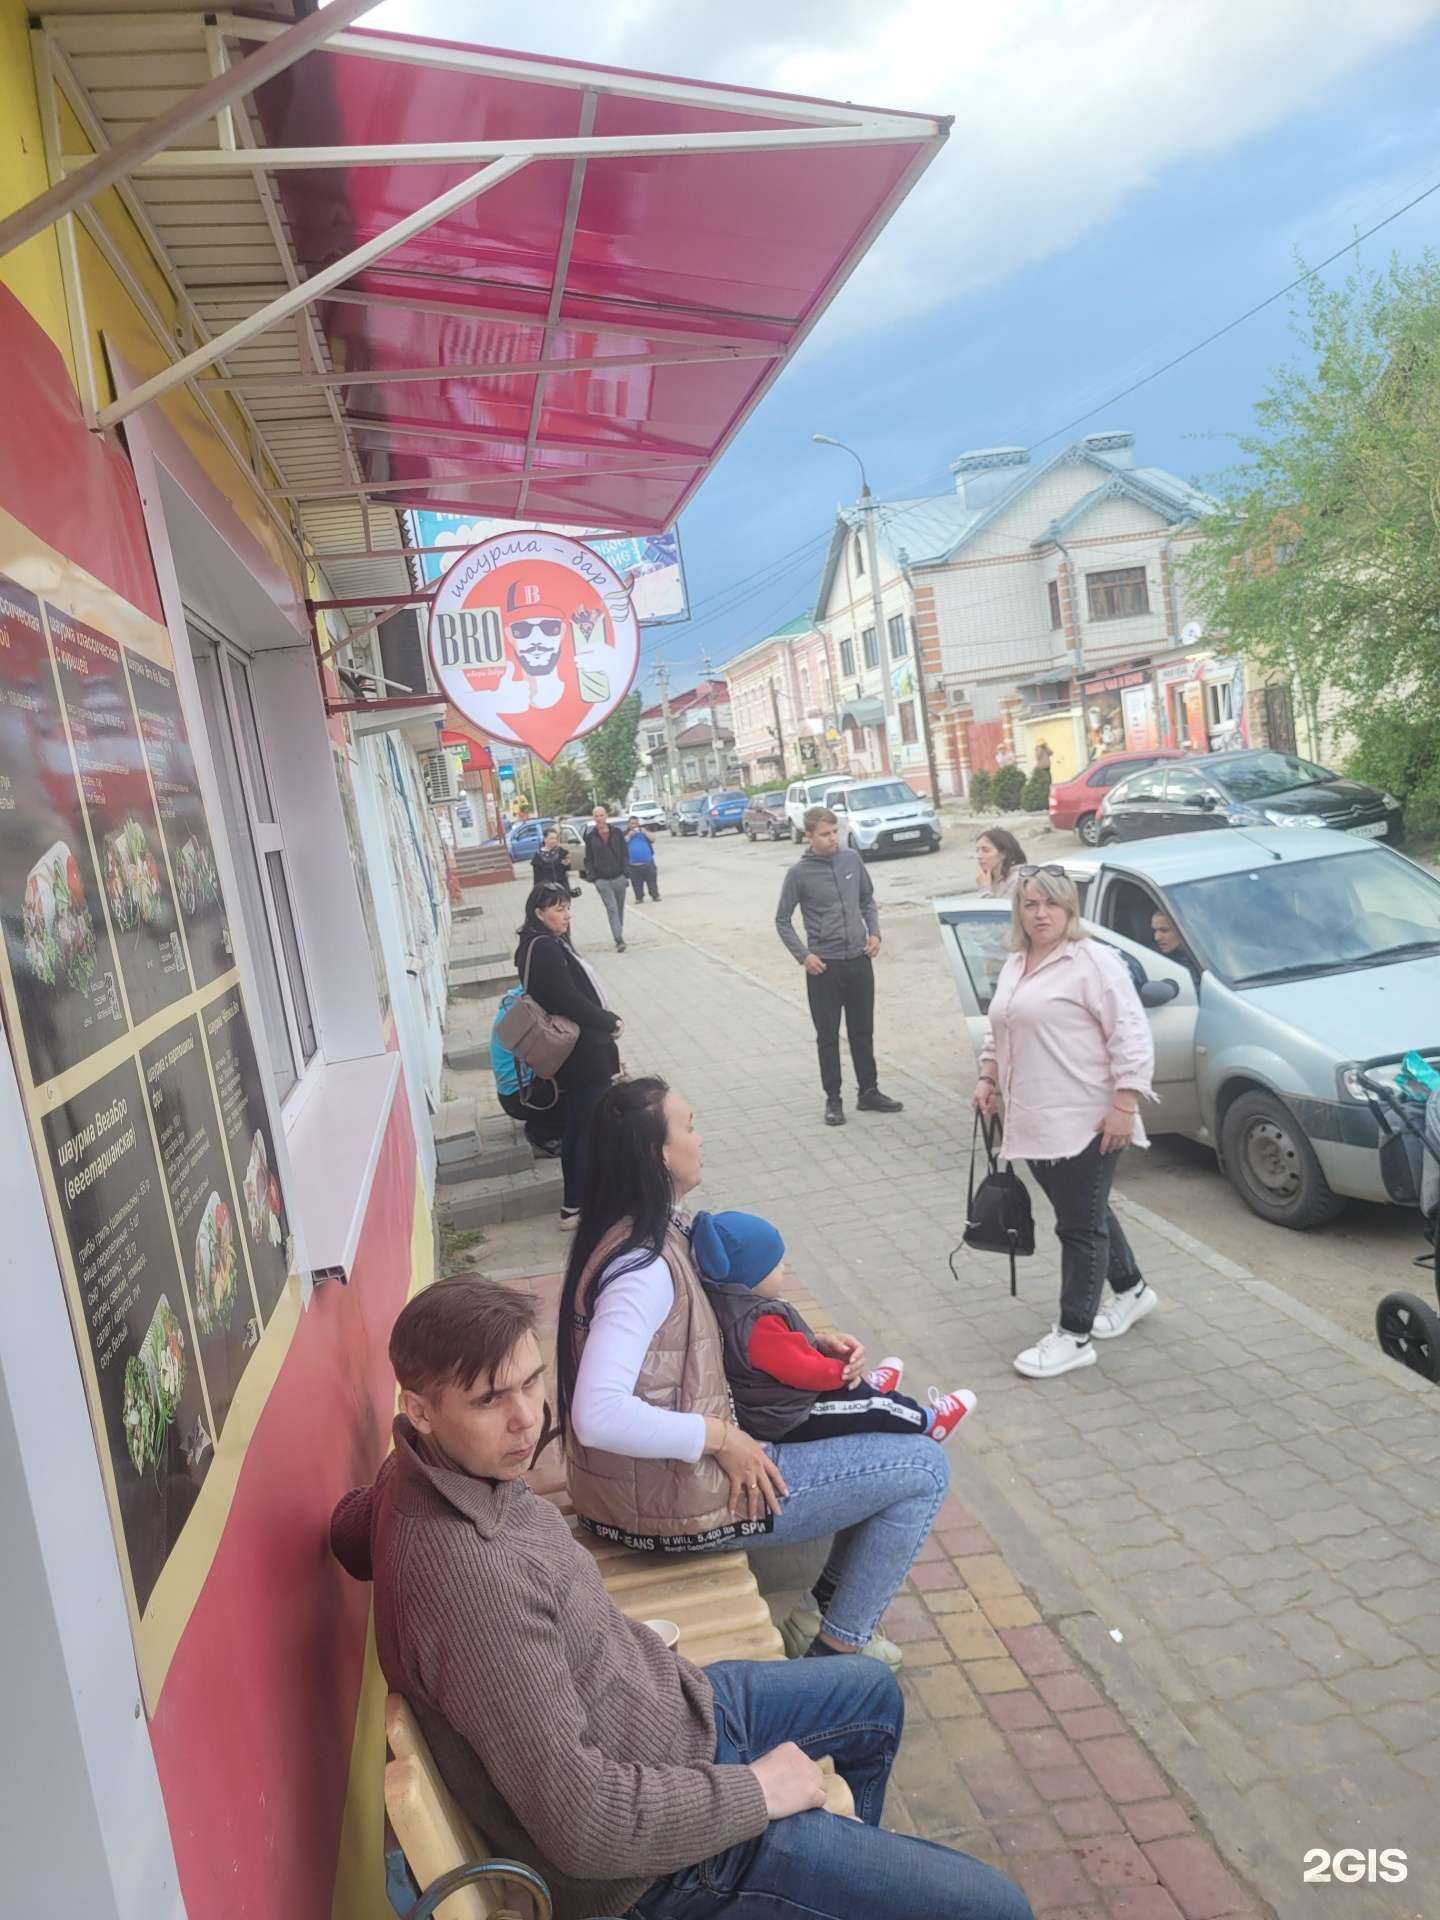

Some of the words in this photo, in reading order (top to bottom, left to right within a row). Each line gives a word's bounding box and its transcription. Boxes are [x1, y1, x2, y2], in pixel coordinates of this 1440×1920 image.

[451, 540, 542, 598] шаурма
[572, 551, 607, 586] бар
[436, 609, 504, 666] BRO
[58, 1123, 96, 1167] шаурма
[64, 1120, 137, 1210] (вегетарианская)
